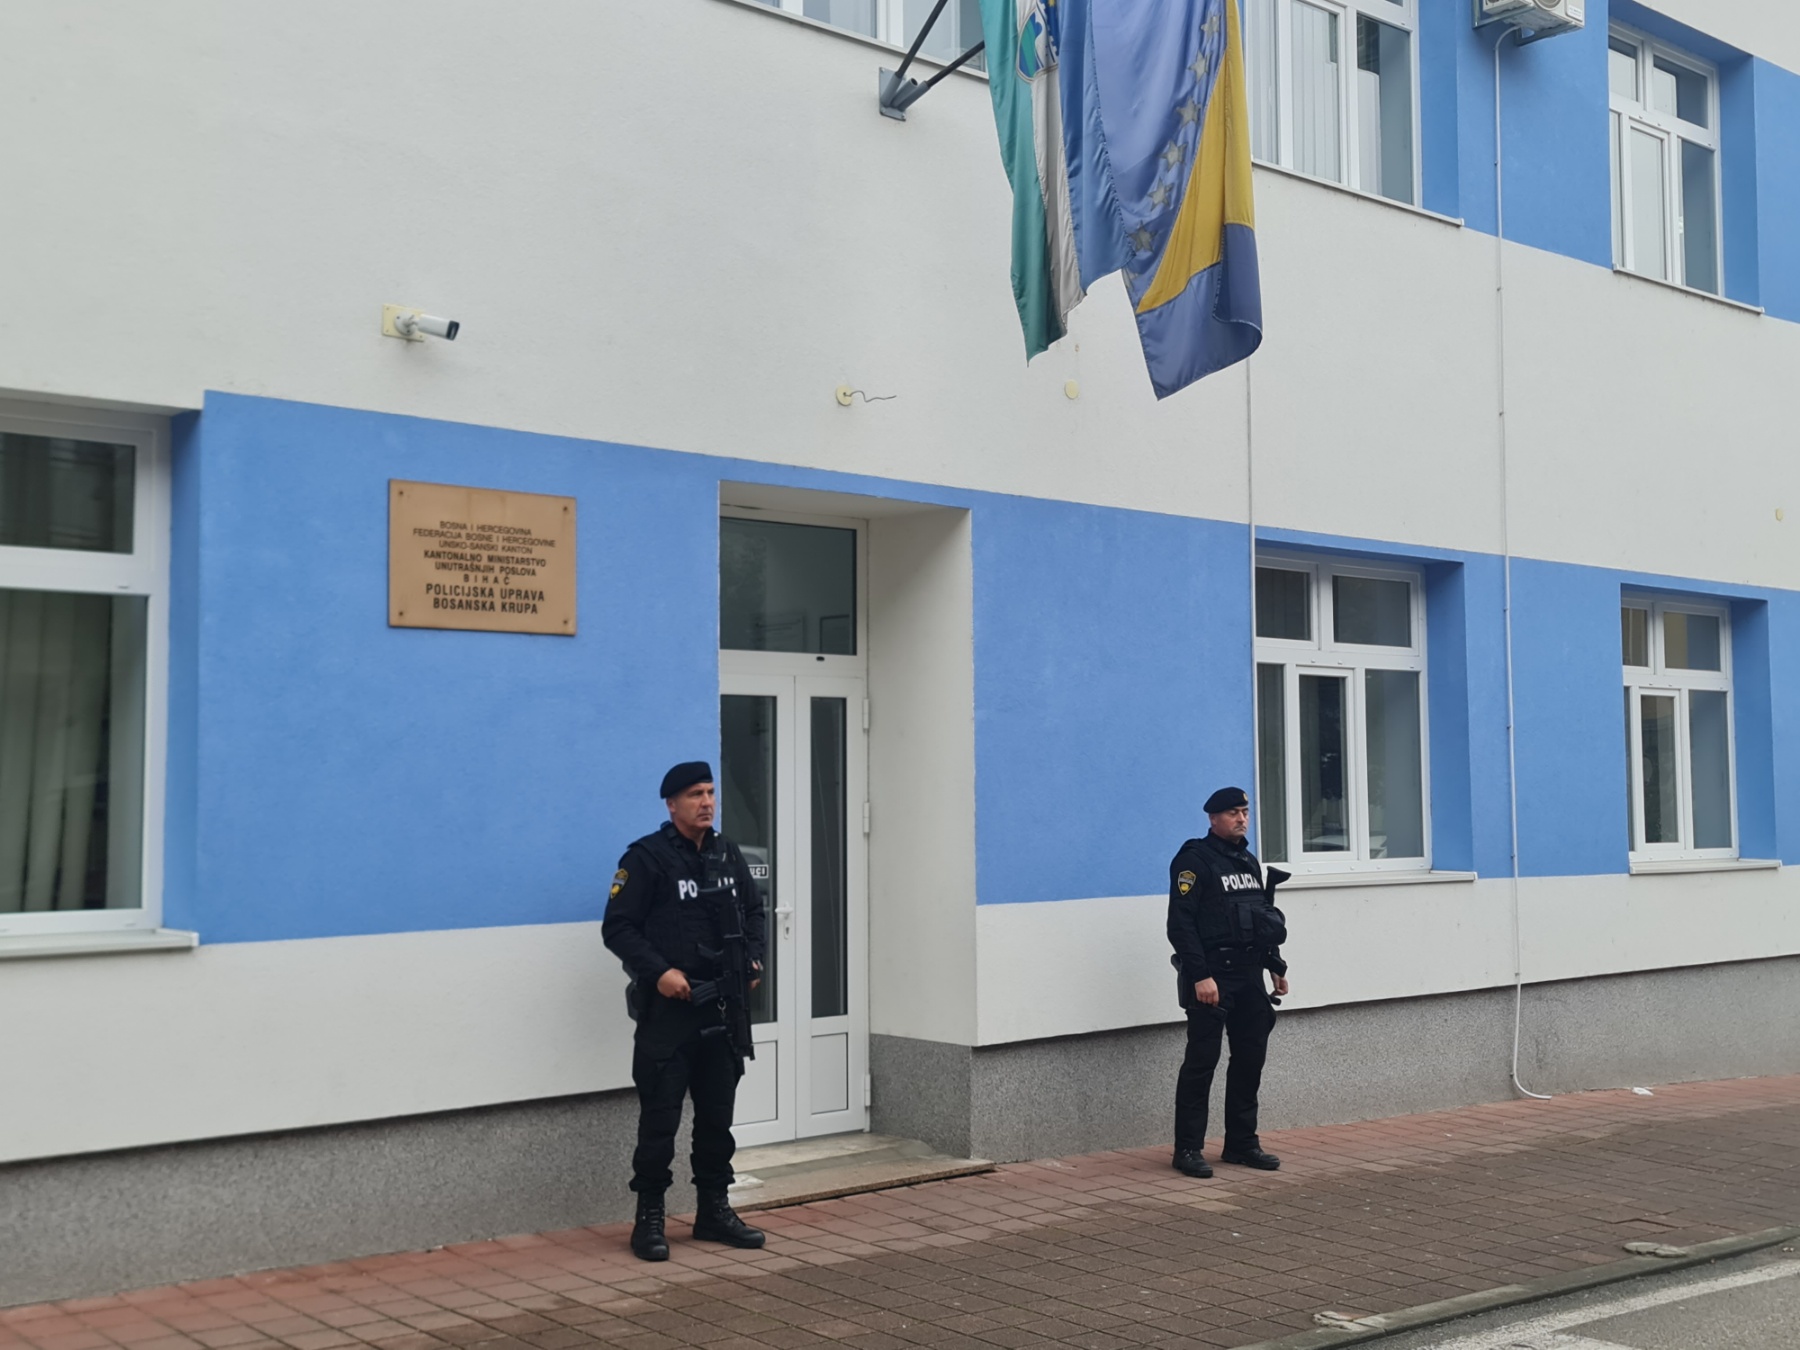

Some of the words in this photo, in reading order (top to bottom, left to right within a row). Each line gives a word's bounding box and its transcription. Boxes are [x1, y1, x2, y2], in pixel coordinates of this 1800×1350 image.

[440, 520, 467, 531] BOSNA
[477, 524, 532, 536] HERCEGOVINA
[413, 527, 462, 539] FEDERACIJA
[465, 532, 493, 542] BOSNE
[502, 535, 556, 548] HERCEGOVINE
[439, 540, 498, 552] UNSKO-SANSKI
[501, 544, 533, 555] KANTON
[423, 550, 483, 562] KANTONALNO
[487, 554, 547, 567] MINISTARSTVO
[435, 561, 495, 574] UNUTRAŠNJIH
[499, 566, 537, 577] POSLOVA
[425, 583, 495, 598] POLICIJSKA
[499, 588, 545, 602] UPRAVA
[433, 597, 496, 613] BOSANSKA
[500, 602, 538, 615] KRUPA
